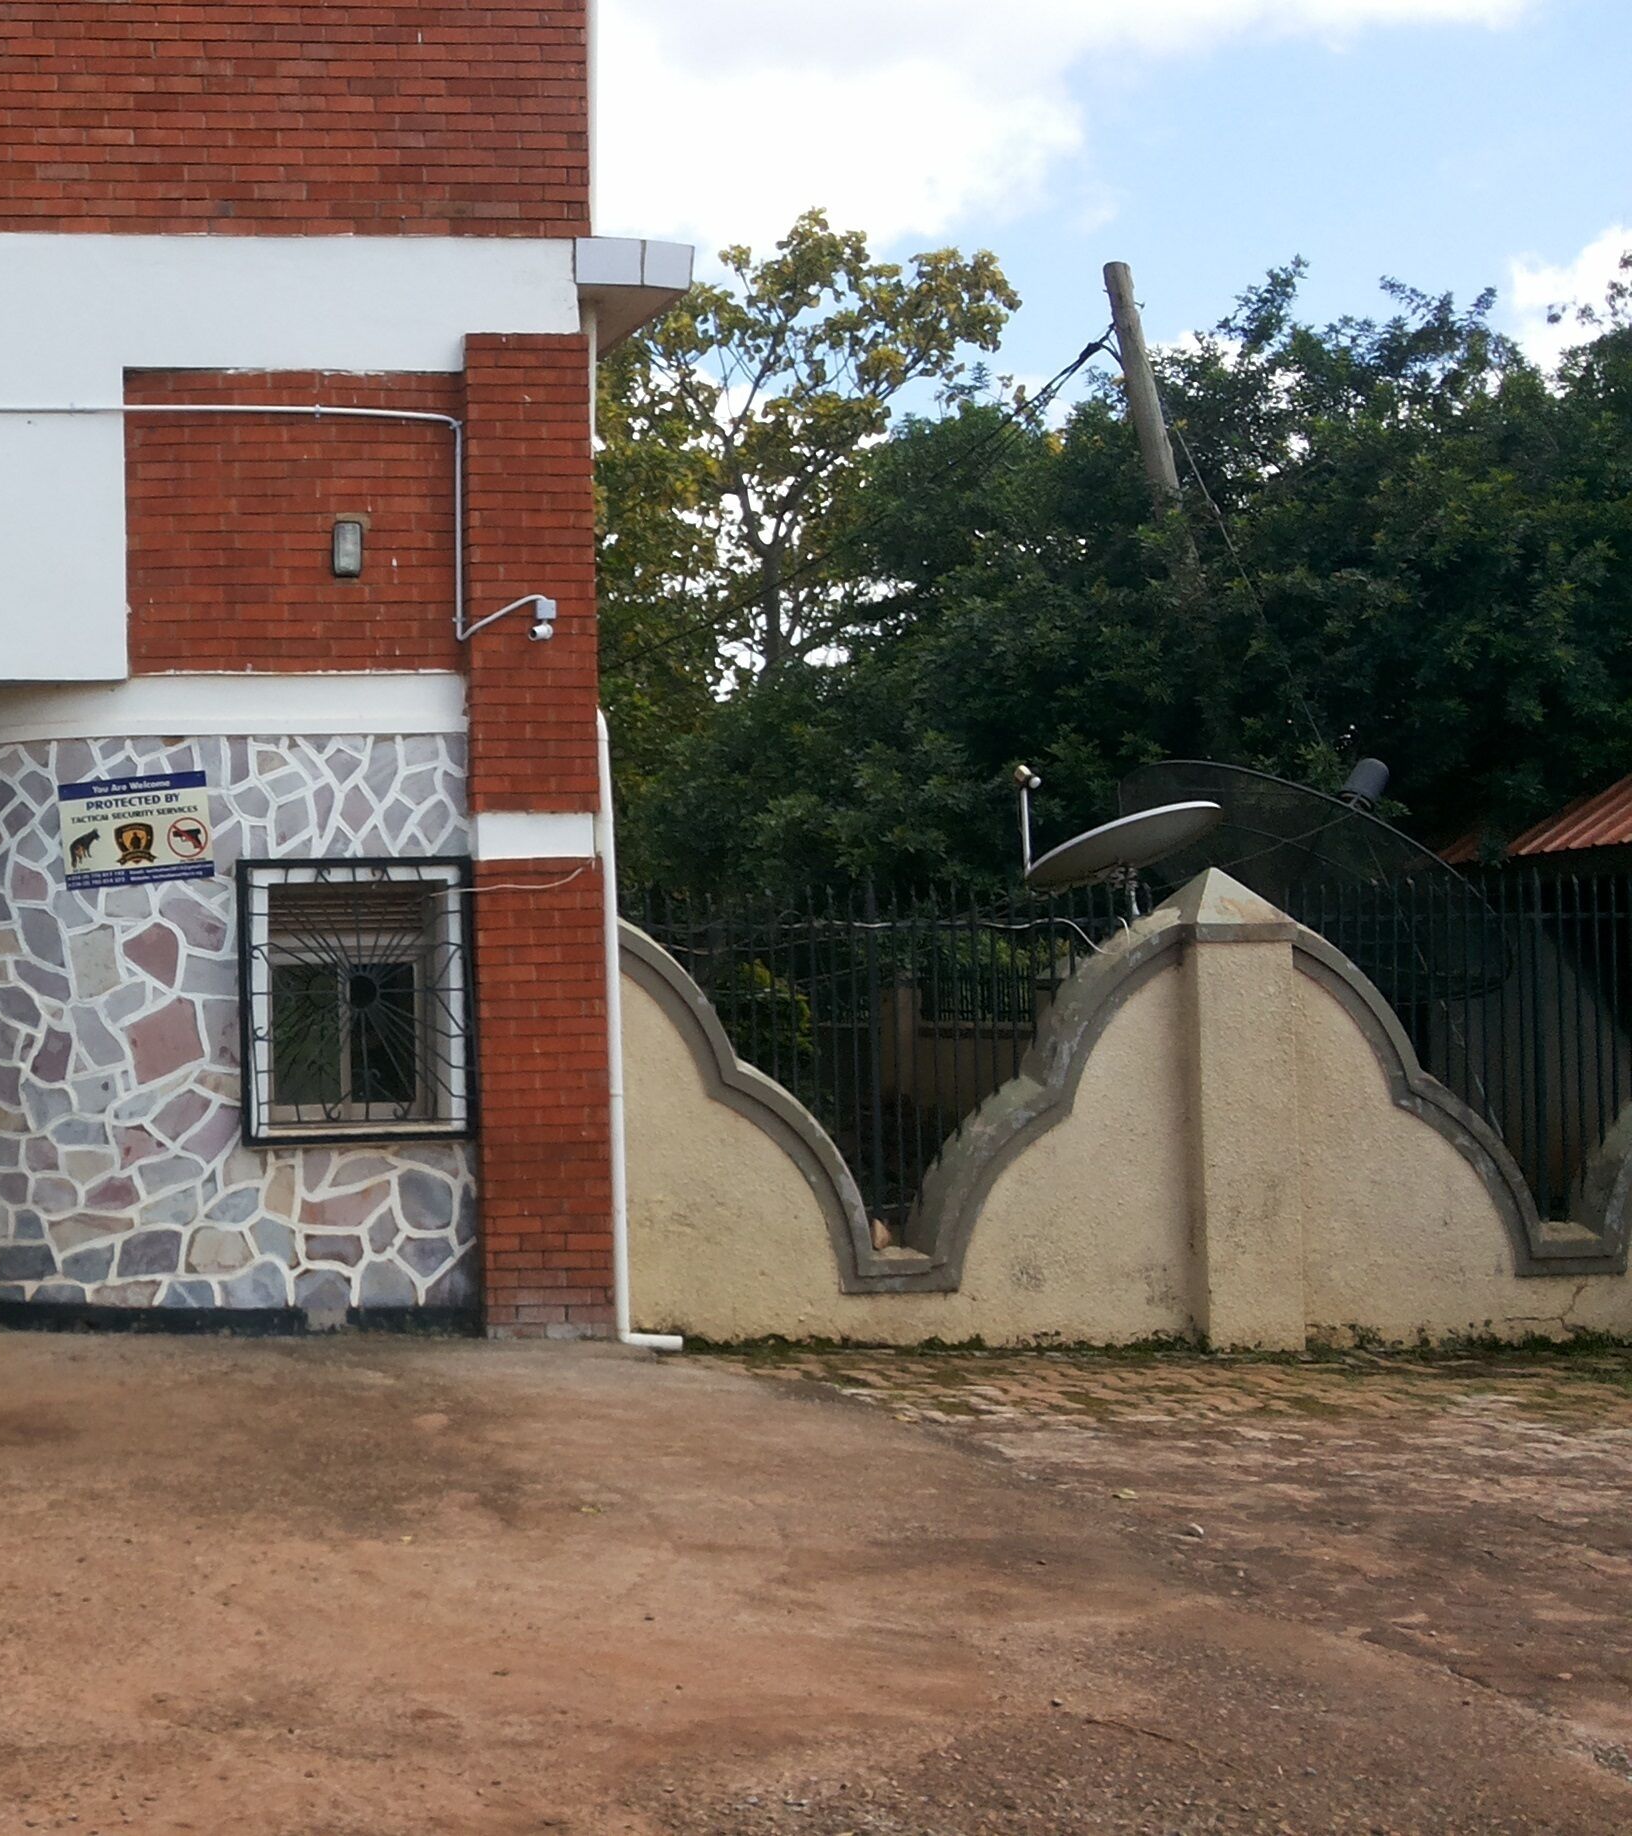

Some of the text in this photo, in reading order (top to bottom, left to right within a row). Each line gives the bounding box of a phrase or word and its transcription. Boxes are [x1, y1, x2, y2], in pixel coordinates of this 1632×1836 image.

[92, 780, 171, 794] You Are Welcome
[86, 792, 180, 811] PROTECTED BY
[111, 809, 154, 820] SECURITY
[156, 805, 198, 816] SERVICES
